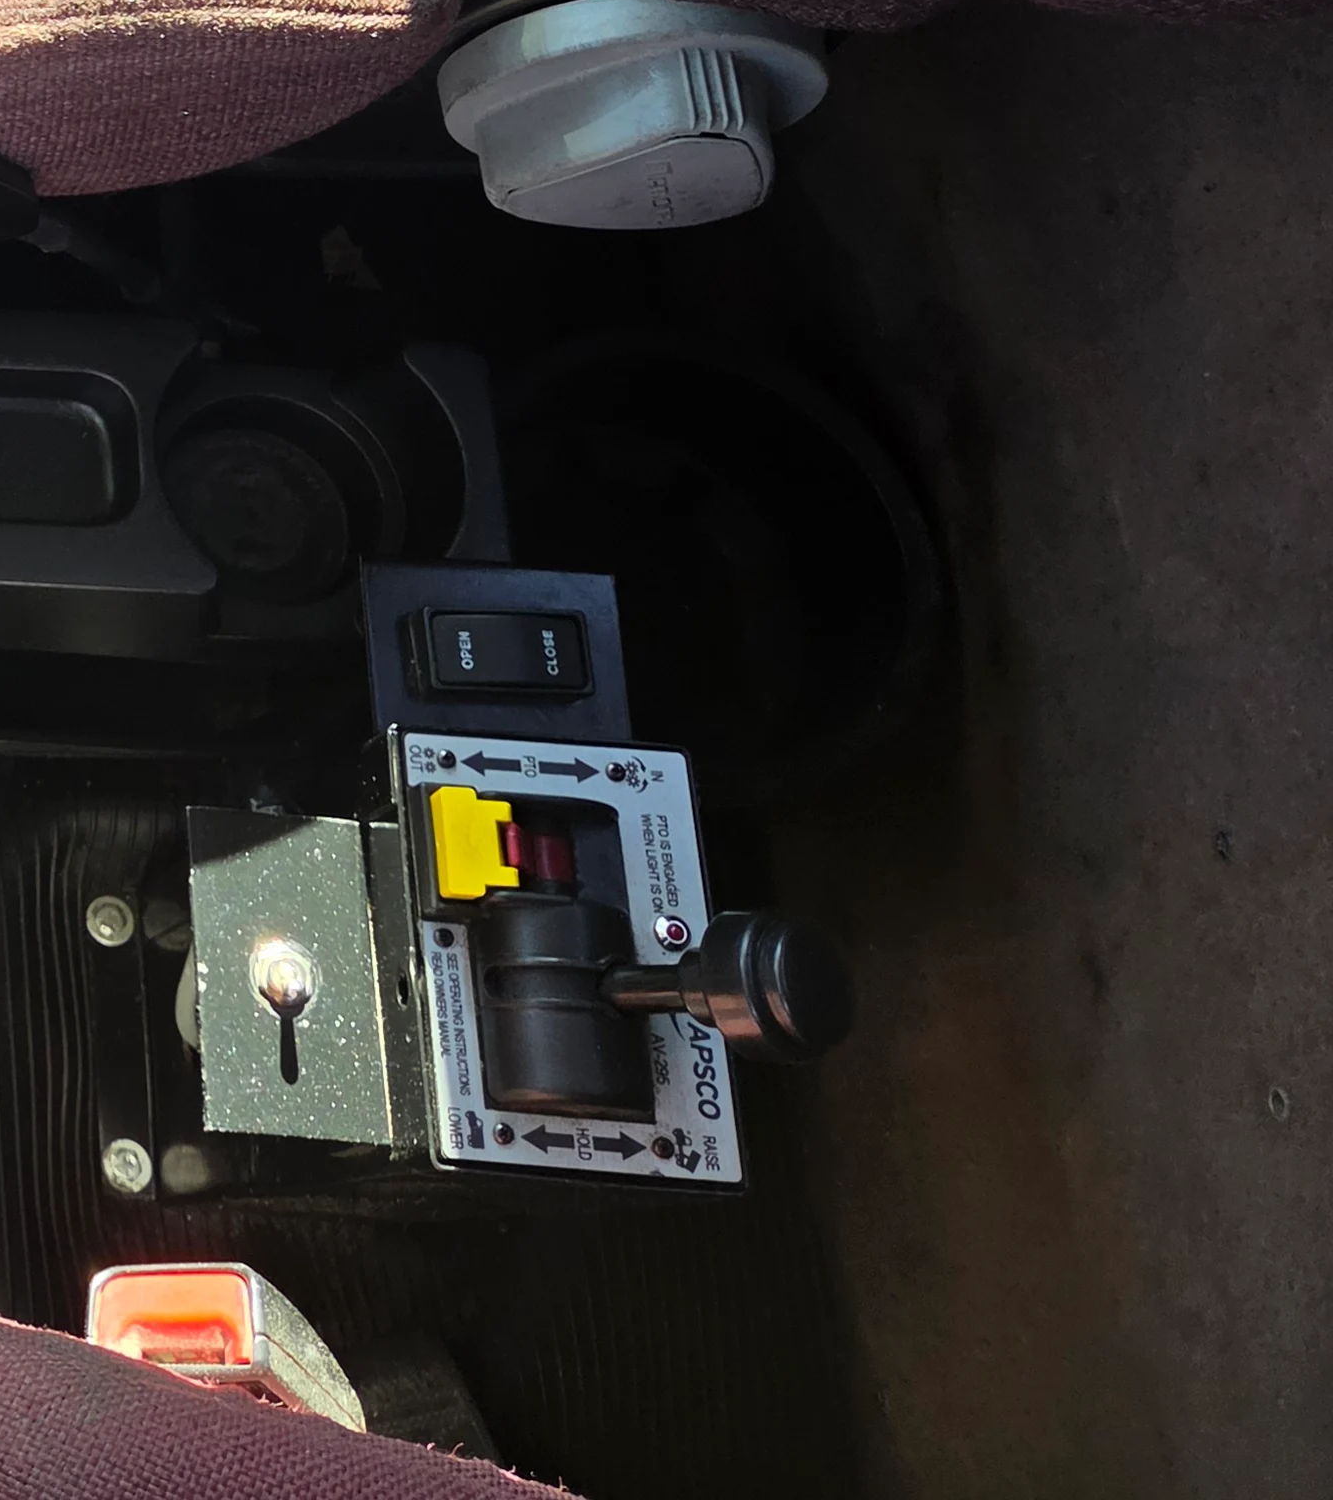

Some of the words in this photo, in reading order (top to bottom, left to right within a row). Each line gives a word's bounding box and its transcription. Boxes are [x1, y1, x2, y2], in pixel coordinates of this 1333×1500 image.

[458, 631, 474, 670] OPEN
[542, 629, 559, 676] CLOSE
[409, 745, 423, 773] OUT
[523, 755, 537, 778] PTO
[651, 770, 664, 783] IN
[641, 814, 654, 846] WHEN
[656, 814, 669, 838] PTO
[660, 839, 671, 850] IS
[646, 848, 660, 881] LIGHT
[662, 853, 679, 908] ENGAGED
[650, 884, 662, 896] IS
[652, 897, 664, 914] ON
[446, 952, 458, 971] SEE
[433, 952, 444, 979] READ
[439, 1023, 451, 1058] MANUAL
[449, 971, 463, 1026] OPERATING
[454, 1027, 471, 1097] INSTRUCTIONS
[650, 1033, 670, 1086] AV-295
[687, 1021, 721, 1120] APSCO
[448, 1106, 463, 1150] LOWER
[576, 1127, 592, 1161] HOLD
[703, 1135, 721, 1172] RAISE
